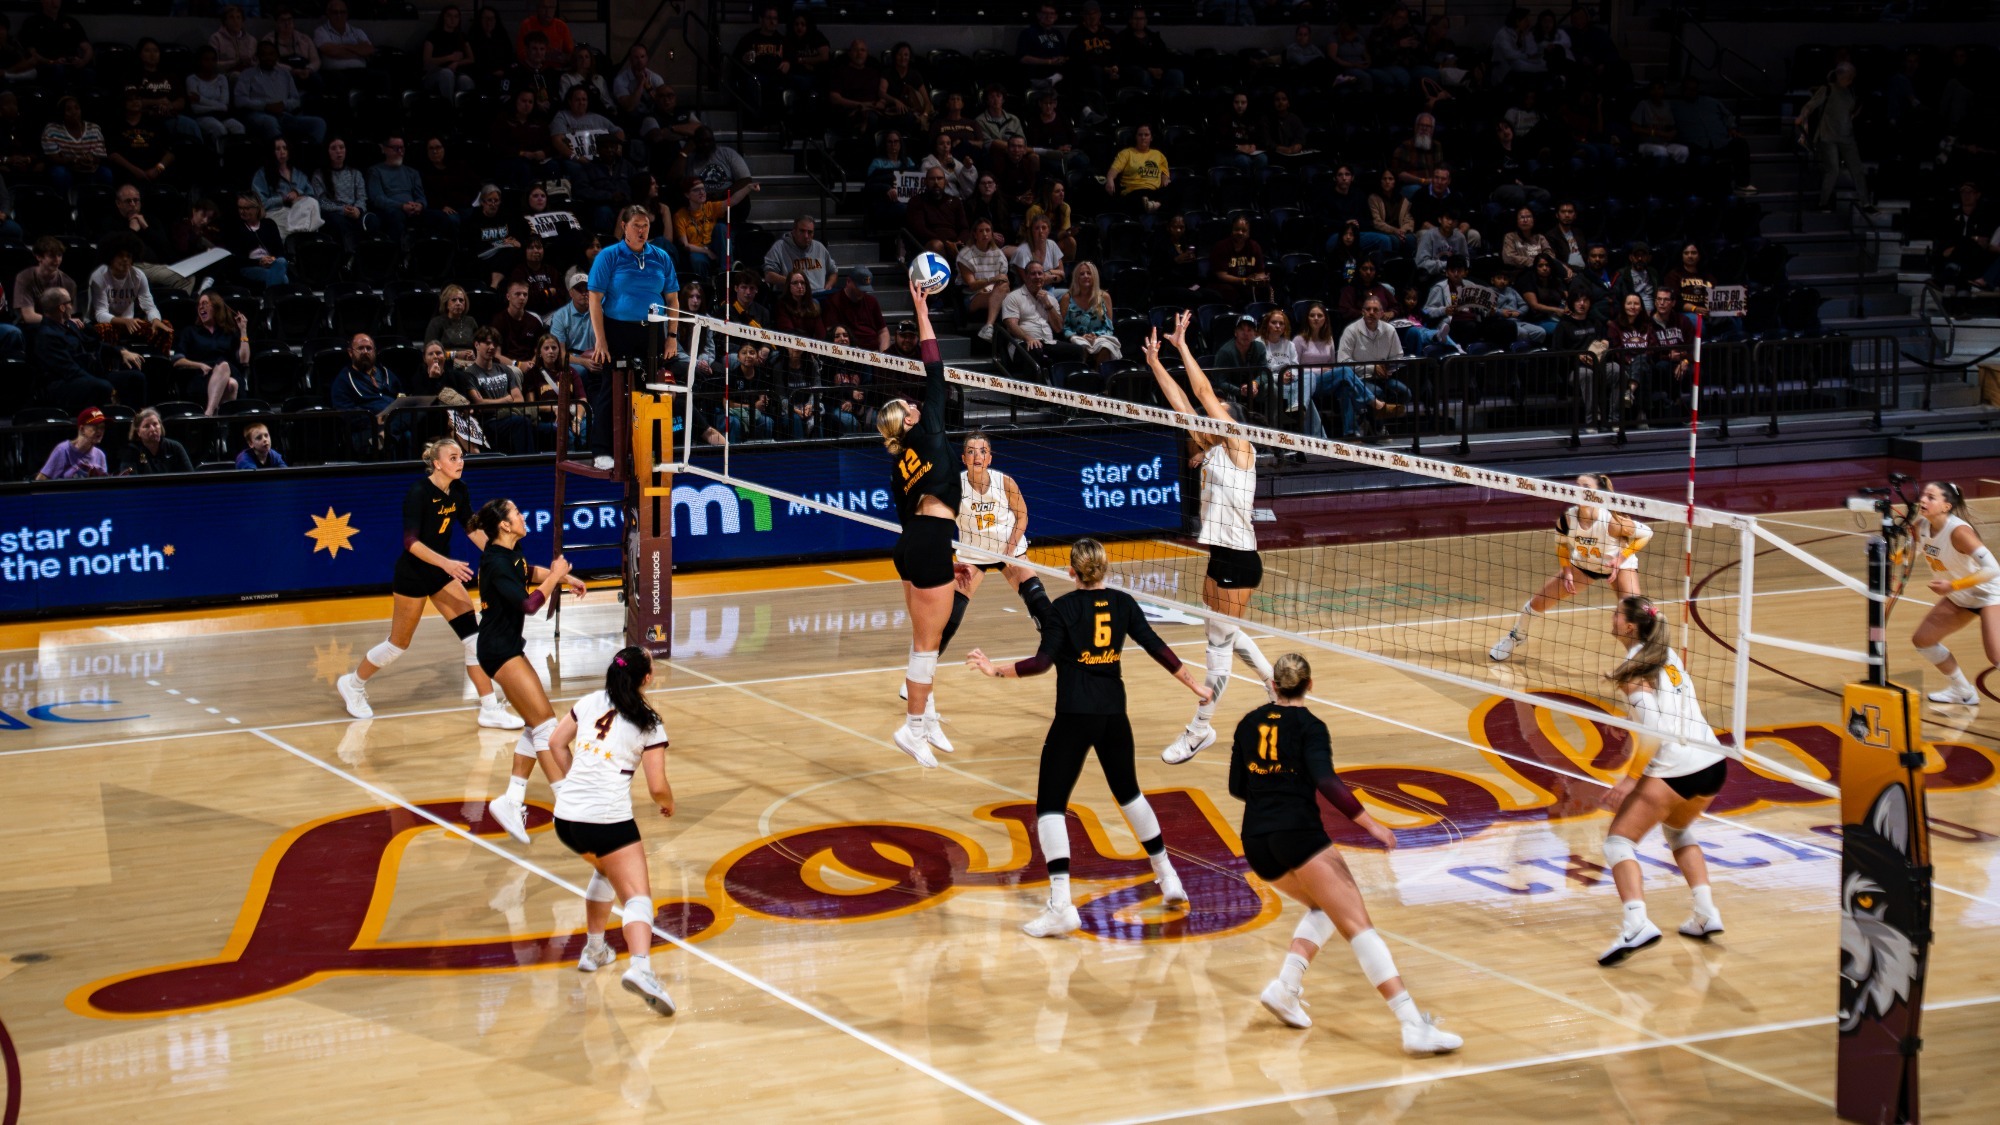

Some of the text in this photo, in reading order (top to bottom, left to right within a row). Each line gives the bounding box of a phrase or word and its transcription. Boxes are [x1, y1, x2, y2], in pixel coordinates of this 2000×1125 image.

[901, 176, 919, 188] LET'S
[1712, 291, 1729, 301] LET'S
[1730, 290, 1740, 301] GO
[899, 447, 921, 480] 12
[1081, 456, 1162, 485] star of
[975, 502, 995, 513] VCU
[1082, 481, 1181, 509] the nort
[0, 518, 113, 554] star of
[975, 514, 996, 531] 12
[0, 544, 165, 582] the north
[651, 551, 661, 615] sports imports
[1094, 612, 1112, 648] 6
[594, 708, 619, 741] 4
[1258, 724, 1279, 761] 11
